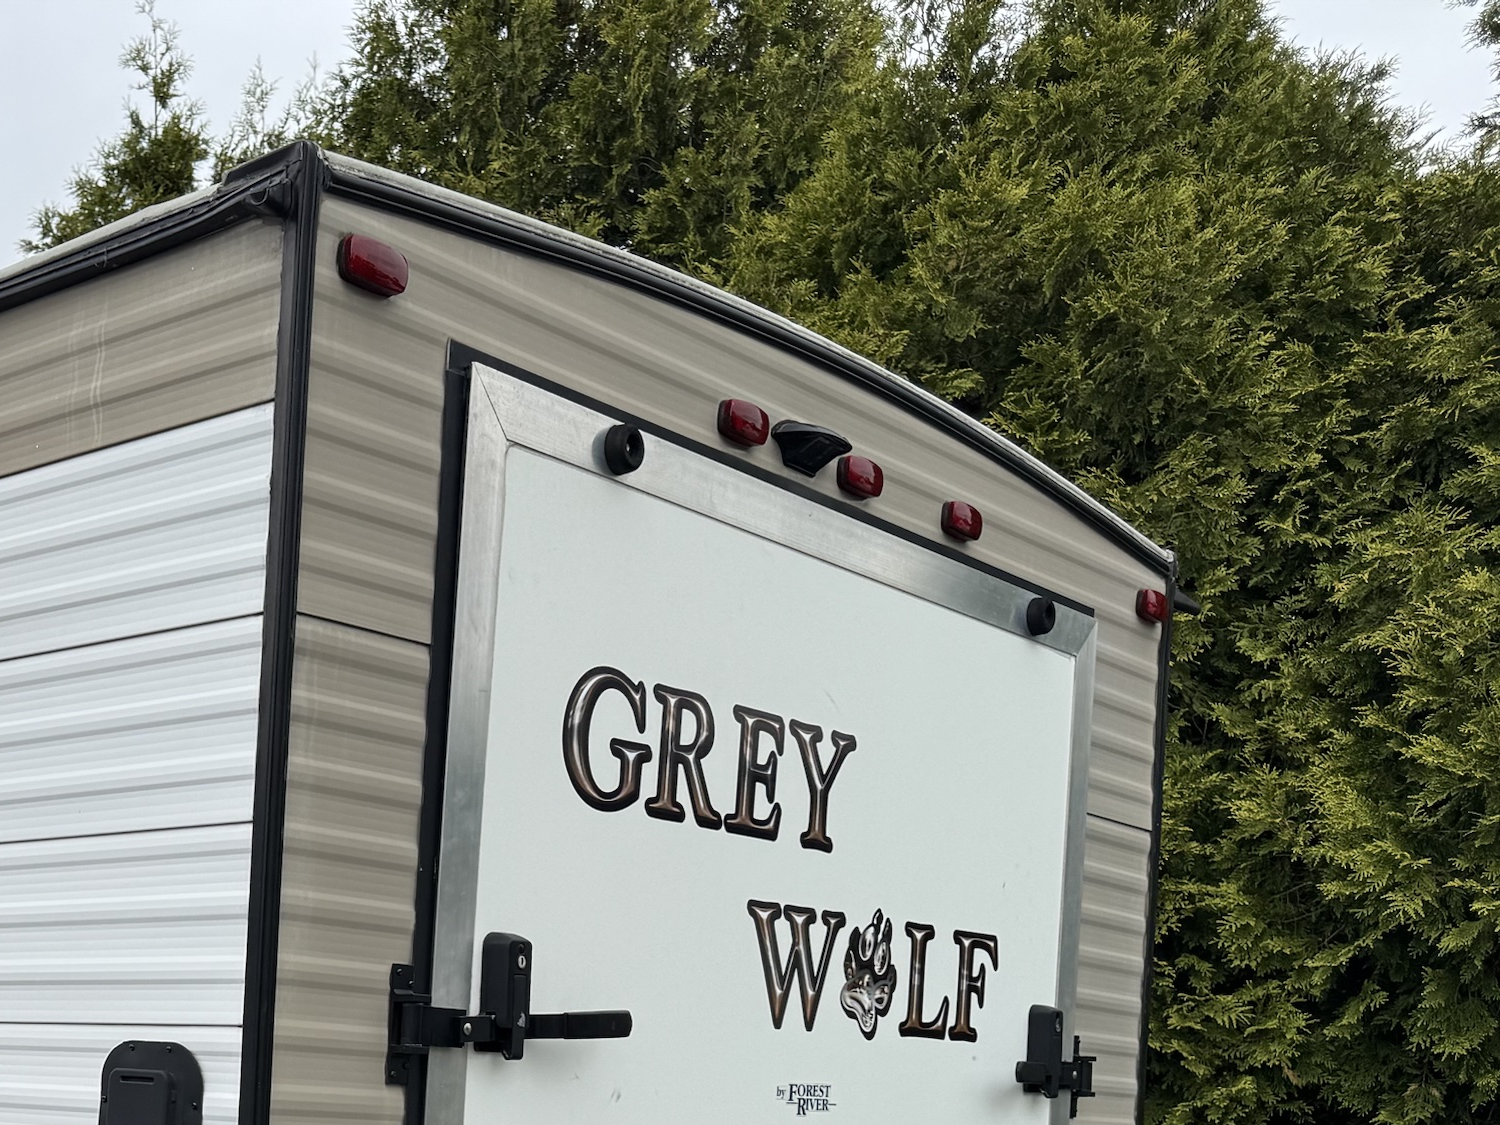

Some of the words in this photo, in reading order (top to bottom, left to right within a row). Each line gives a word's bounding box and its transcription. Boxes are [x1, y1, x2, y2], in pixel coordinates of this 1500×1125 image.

[562, 664, 857, 854] GREY
[776, 1086, 786, 1099] by
[788, 1083, 831, 1102] FOREST
[796, 1097, 829, 1116] RIVER
